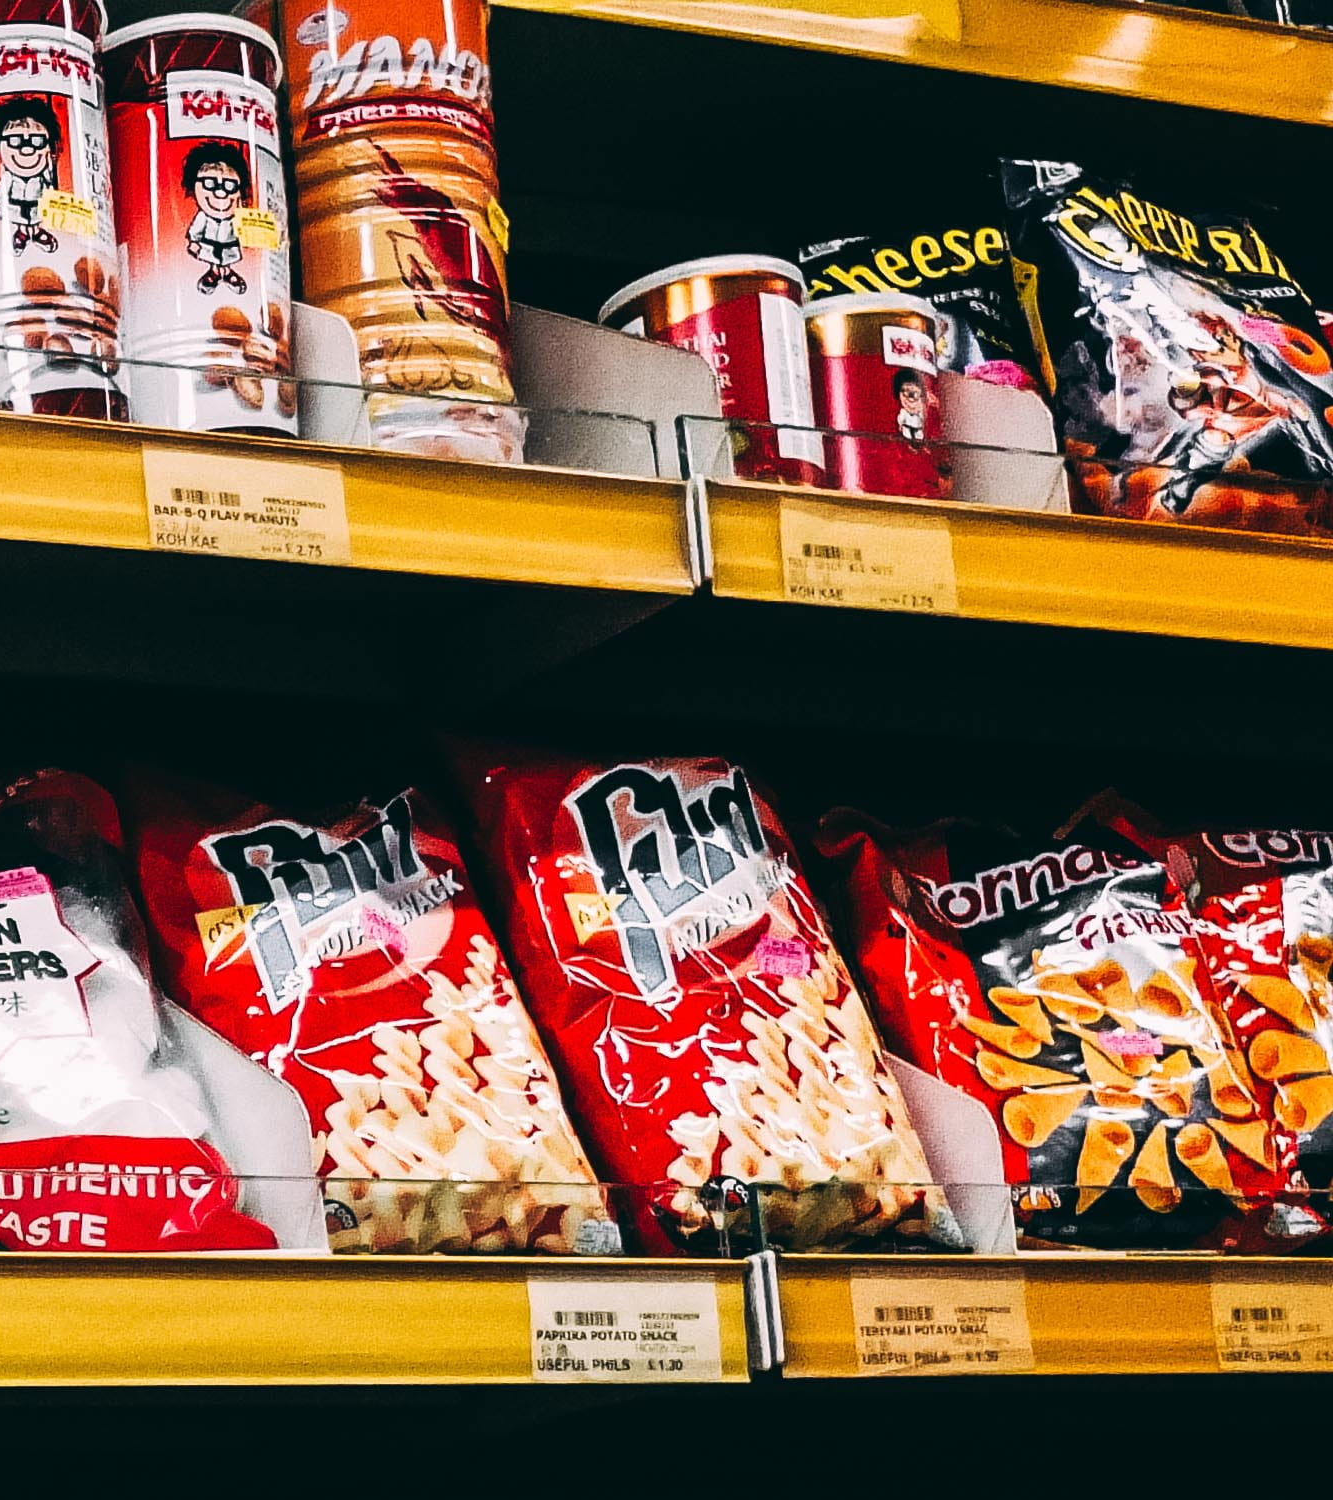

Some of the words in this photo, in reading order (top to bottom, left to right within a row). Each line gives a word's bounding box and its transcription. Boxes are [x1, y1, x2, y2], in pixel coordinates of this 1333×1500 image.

[807, 227, 1004, 297] heese
[210, 508, 241, 522] FLAV
[156, 531, 188, 547] KOH
[191, 535, 220, 550] KAE
[536, 1330, 588, 1342] PAPRIKA
[590, 1330, 638, 1342] POTATO
[639, 1331, 679, 1342] SNACK
[537, 1358, 589, 1372] USEFUL
